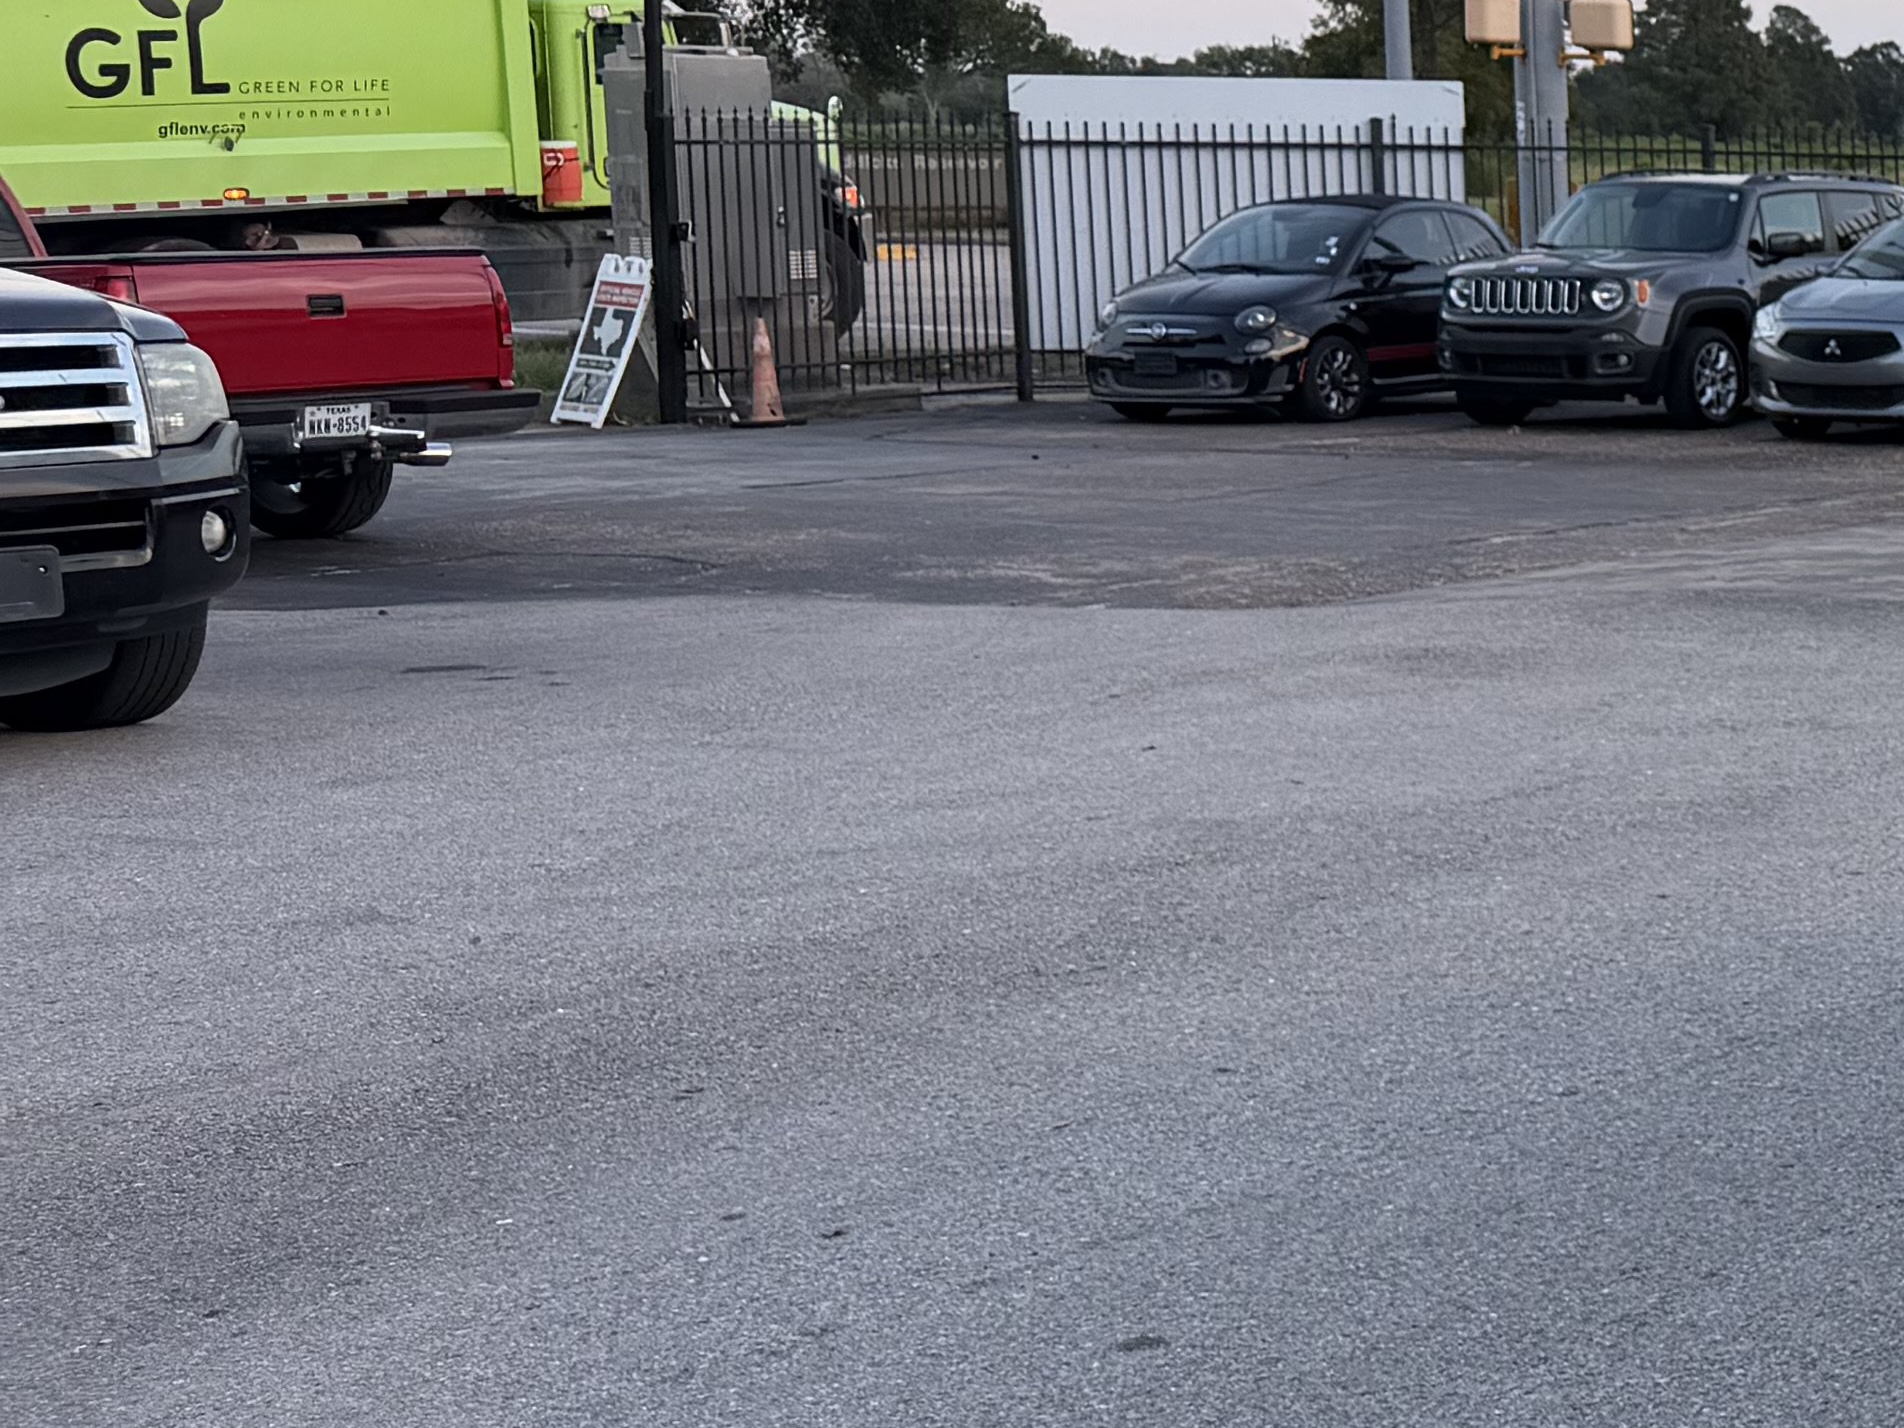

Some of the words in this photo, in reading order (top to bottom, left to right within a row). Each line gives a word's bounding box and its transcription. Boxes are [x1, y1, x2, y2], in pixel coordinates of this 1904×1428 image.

[238, 80, 300, 95] GREEN
[310, 79, 345, 93] FOR
[353, 78, 390, 92] LIFE
[238, 105, 391, 120] environmental
